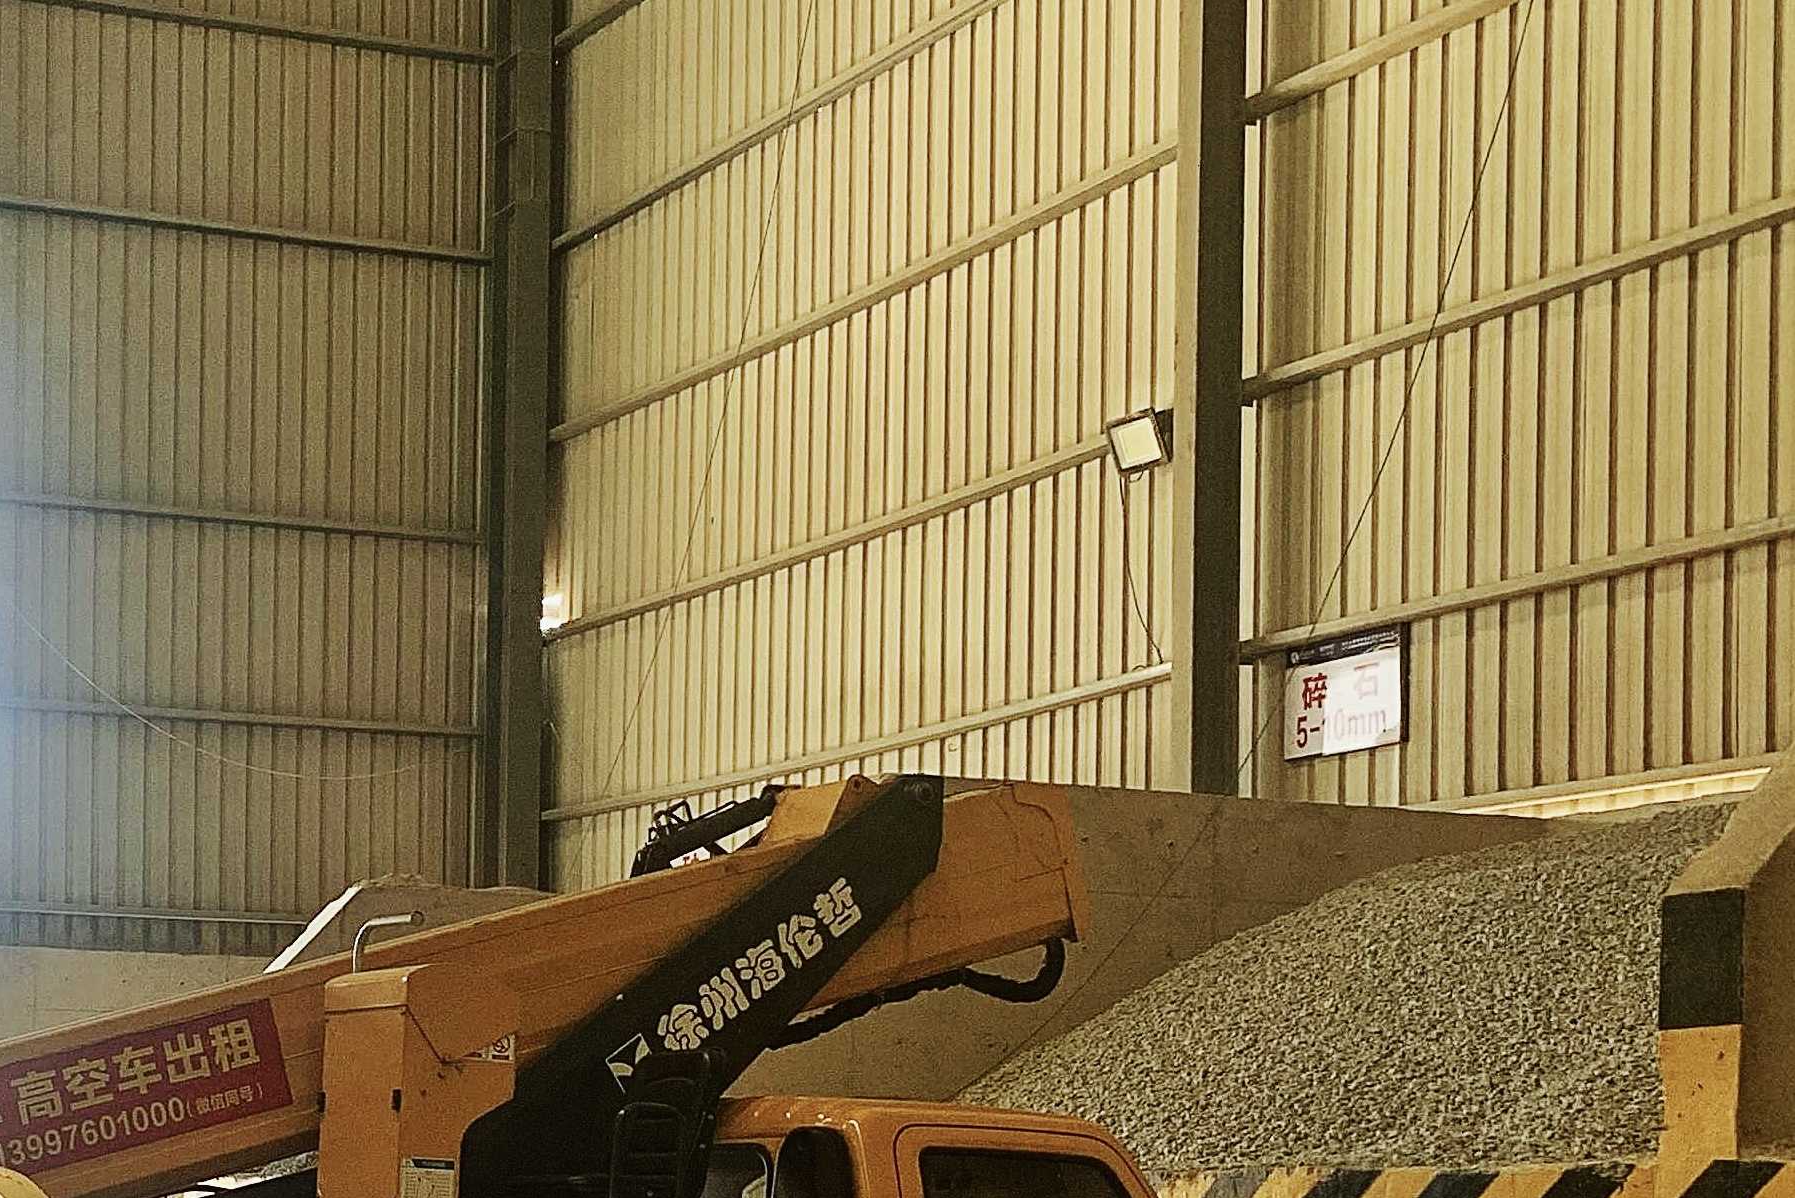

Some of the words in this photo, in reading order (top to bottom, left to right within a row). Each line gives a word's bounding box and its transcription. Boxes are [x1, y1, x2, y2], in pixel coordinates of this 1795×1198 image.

[657, 876, 863, 1051] 徐州海伦哲
[10, 1017, 261, 1126] 高空车出租
